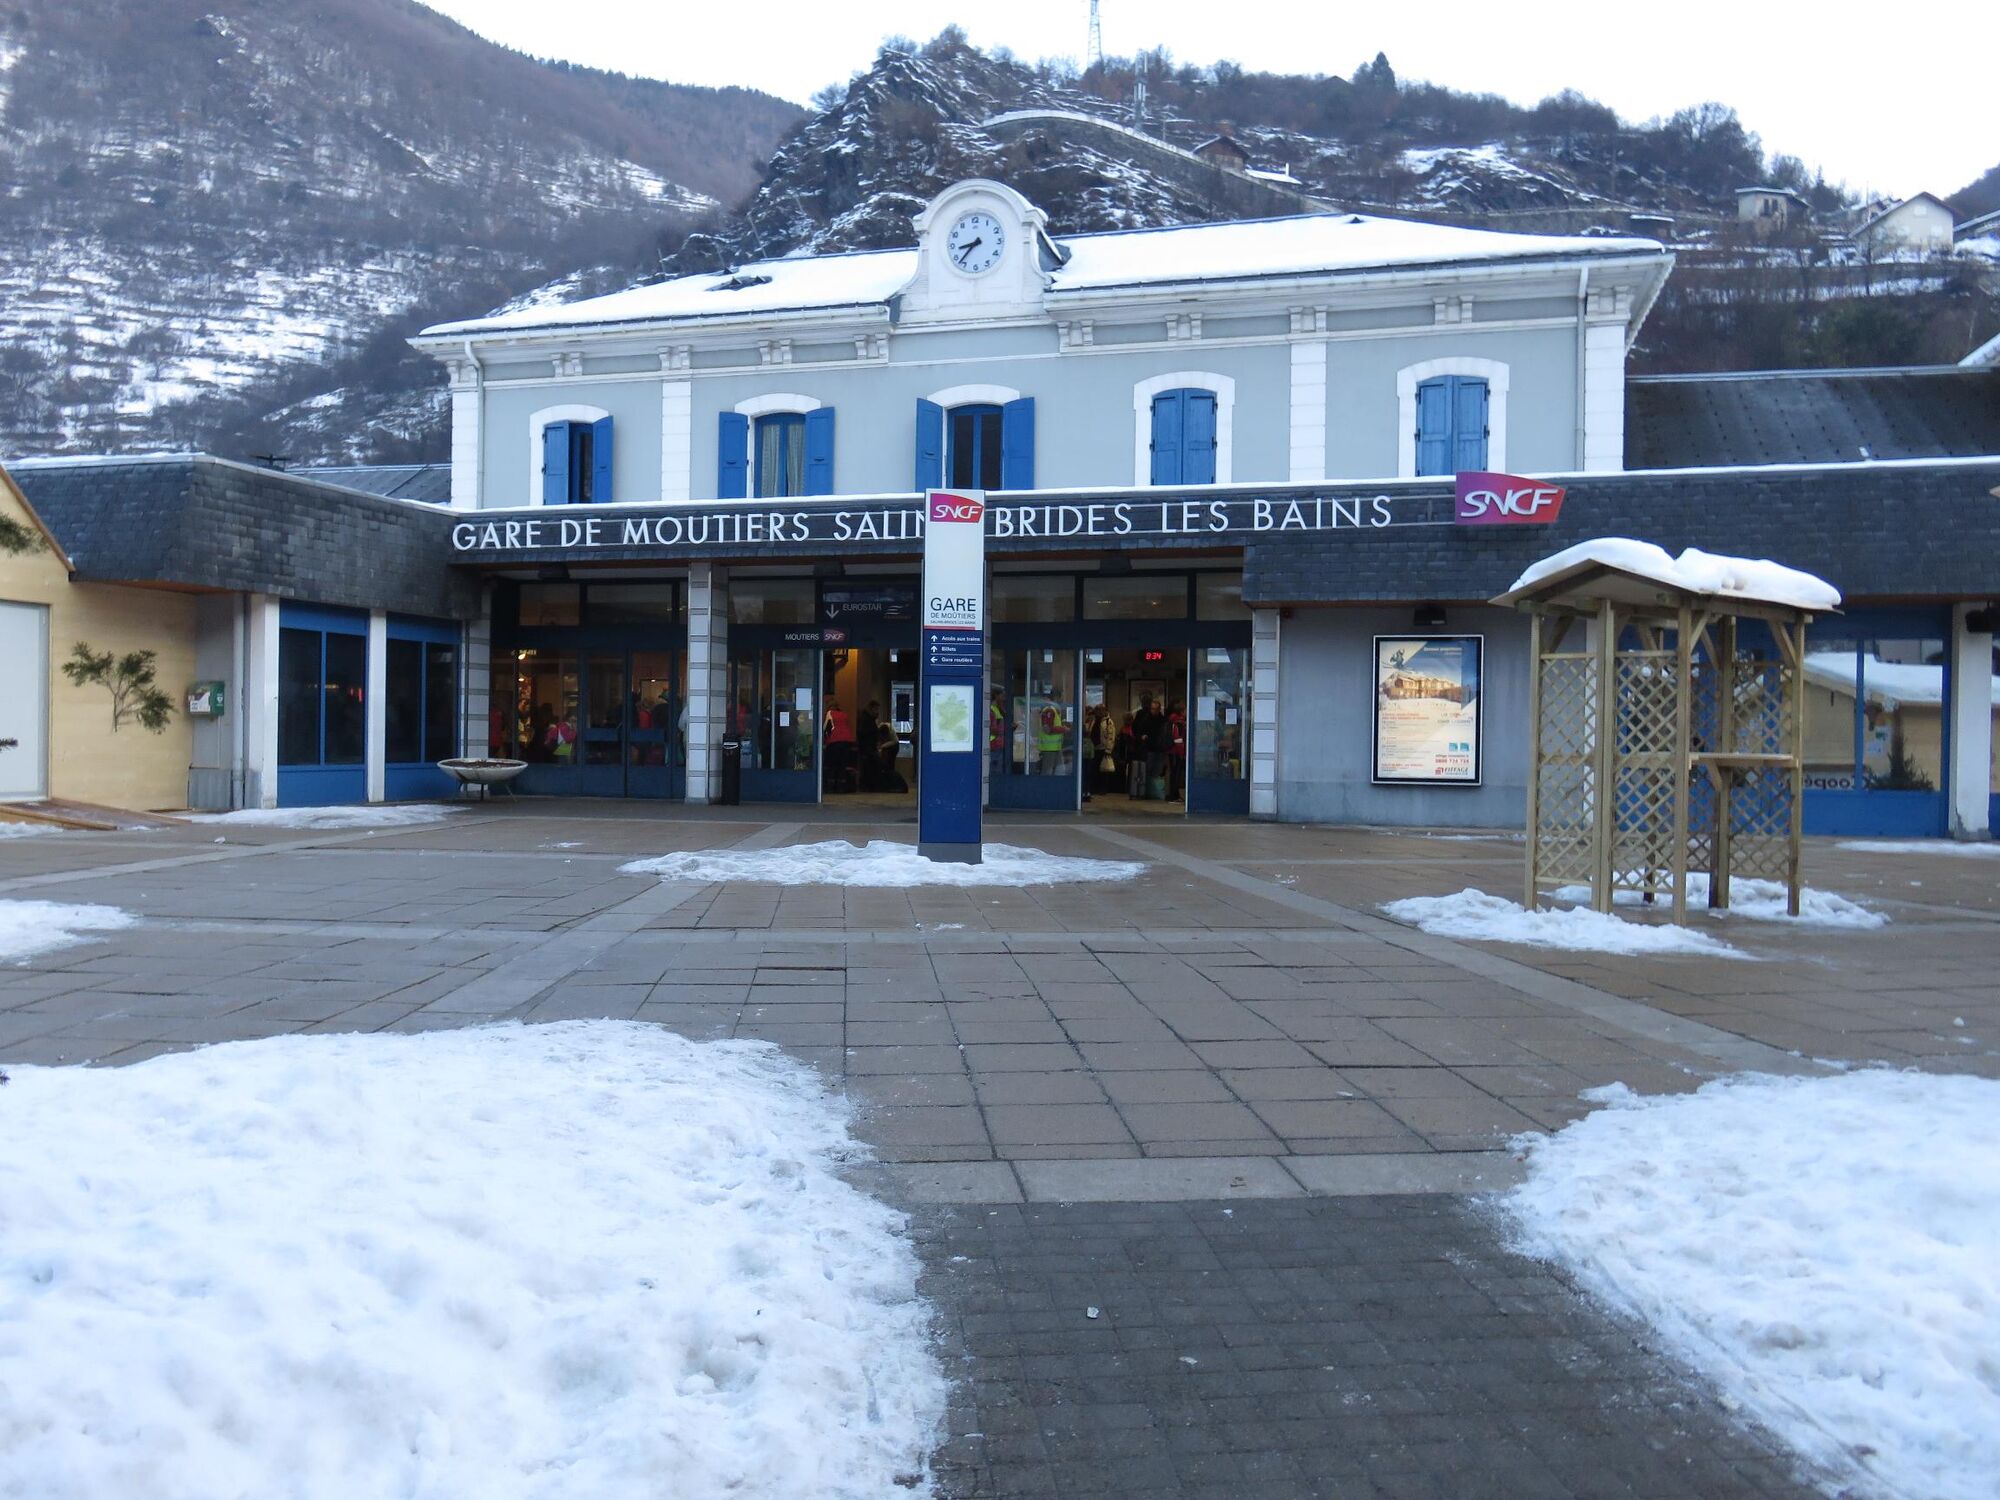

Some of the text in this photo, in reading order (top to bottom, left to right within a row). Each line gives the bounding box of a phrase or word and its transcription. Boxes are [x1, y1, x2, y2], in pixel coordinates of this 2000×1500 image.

[1460, 488, 1558, 517] SNCF
[933, 504, 982, 519] SNCF
[452, 520, 541, 551] GARE
[561, 518, 601, 547] DE
[622, 512, 810, 545] MOUTIERS
[995, 502, 1132, 537] BRIDES
[1161, 500, 1229, 533] LES
[1253, 495, 1392, 531] BAINS
[842, 603, 882, 611] EUROSTAR
[930, 597, 977, 612] GARE
